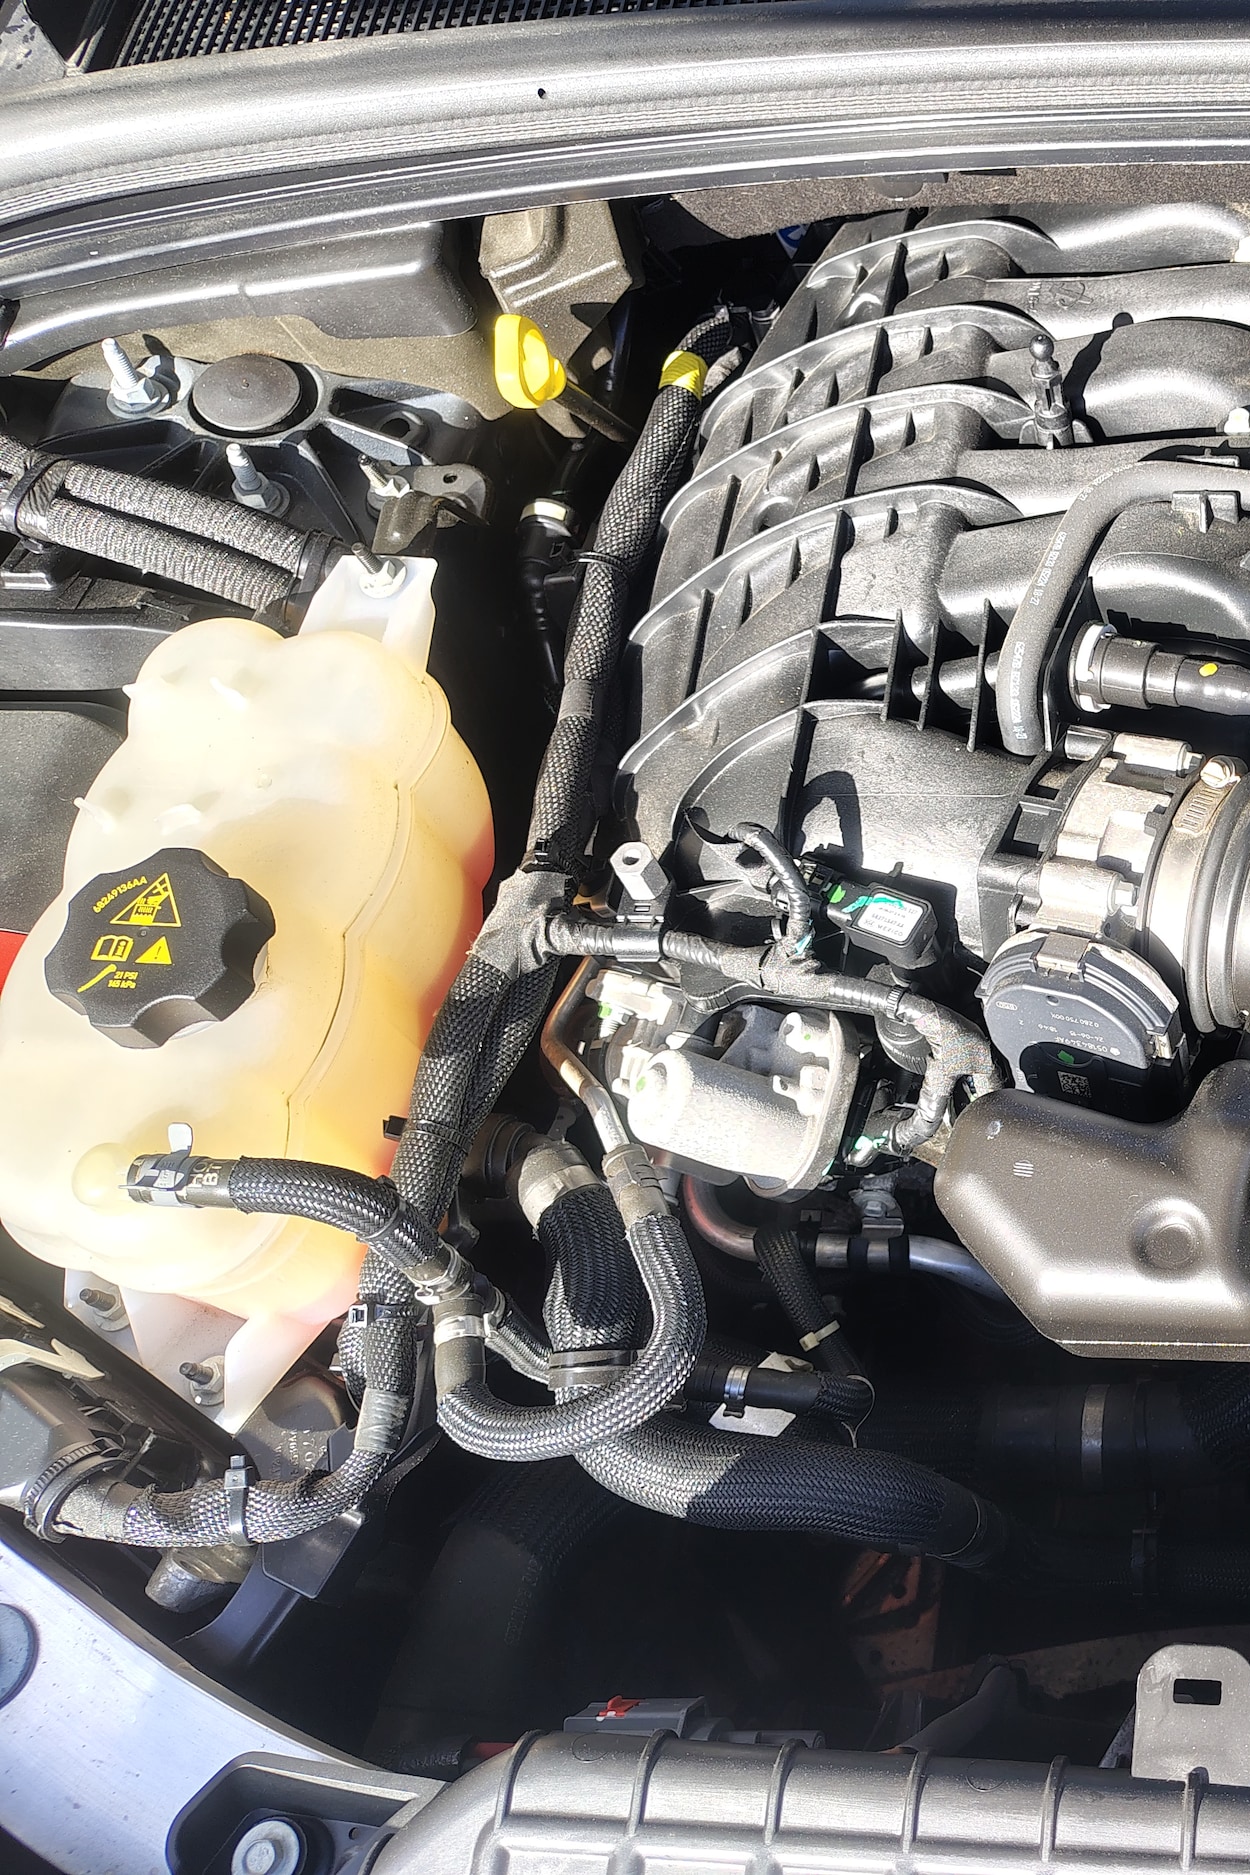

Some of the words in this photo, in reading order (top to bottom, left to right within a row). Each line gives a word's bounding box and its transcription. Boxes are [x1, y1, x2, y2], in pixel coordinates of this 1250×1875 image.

[93, 876, 148, 913] 68249136AA
[114, 971, 123, 980] 21
[123, 971, 138, 980] PSI
